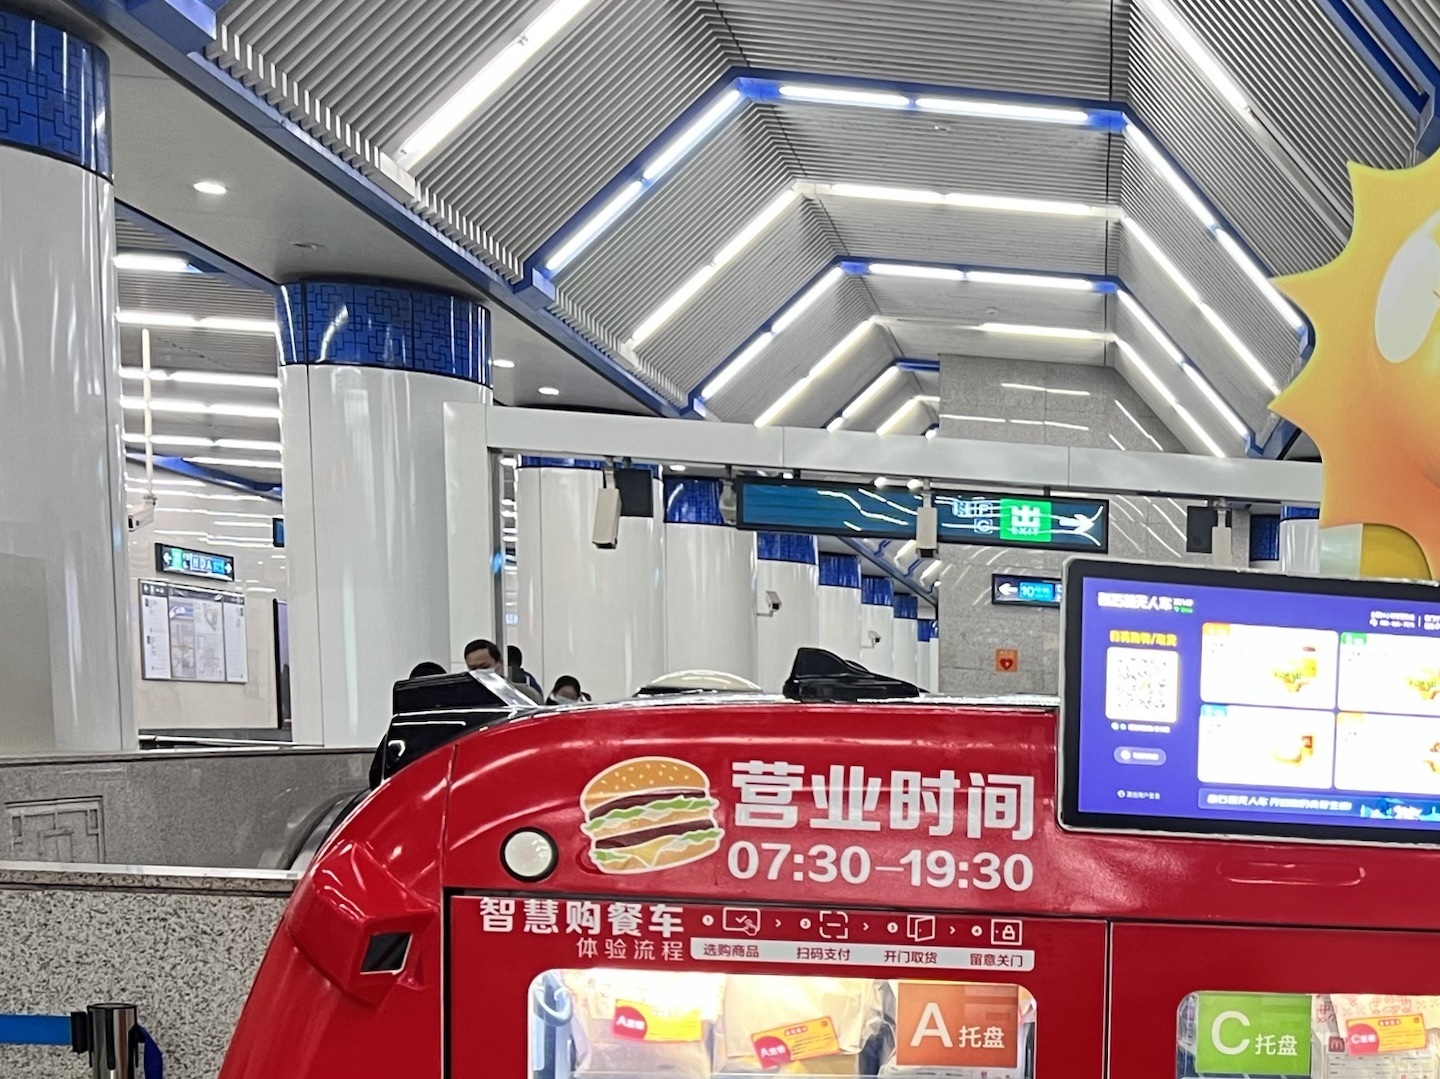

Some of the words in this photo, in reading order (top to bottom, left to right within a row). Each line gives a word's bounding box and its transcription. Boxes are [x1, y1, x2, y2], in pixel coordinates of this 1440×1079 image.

[1011, 505, 1040, 527] 出
[731, 761, 1035, 841] 营业时间
[480, 897, 685, 938] 智慧购餐车
[576, 937, 685, 961] 体验流程
[703, 943, 760, 958] 选购商品
[796, 946, 851, 961] 扫码支付
[884, 950, 938, 964] 开门取货
[970, 953, 1023, 967] 留意关门
[905, 1002, 1005, 1048] A托盘
[1211, 1010, 1298, 1056] C托盘
